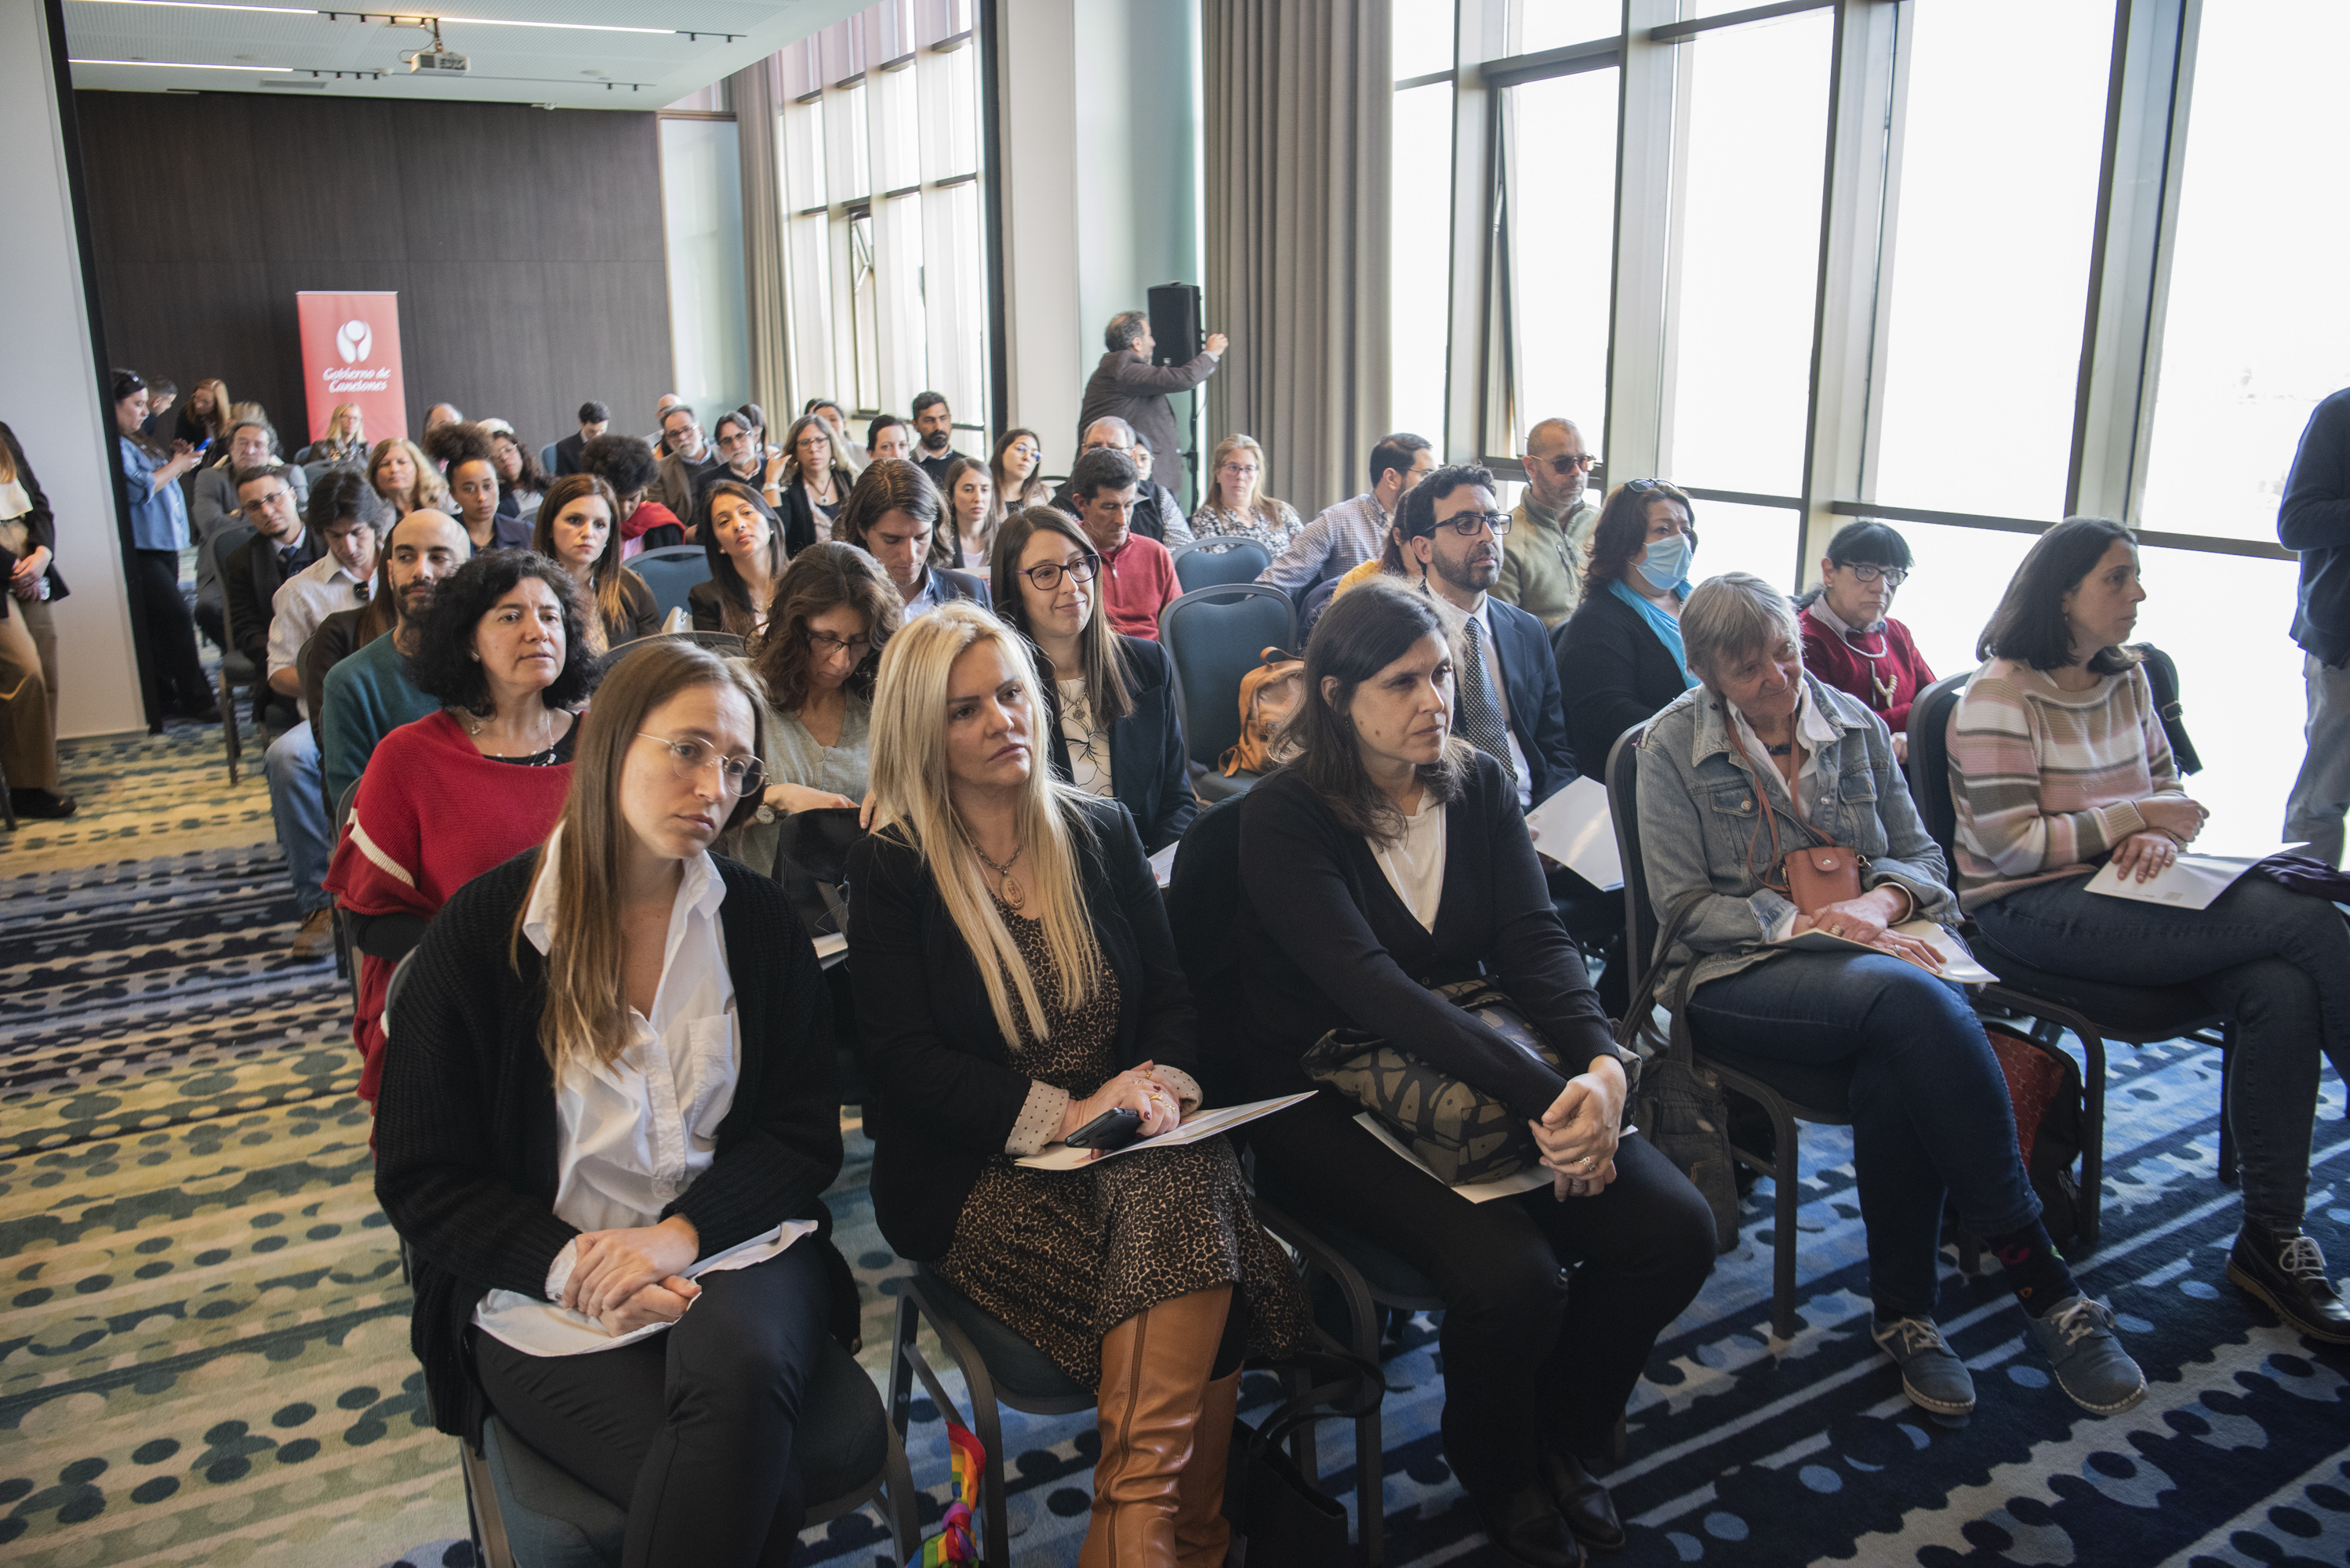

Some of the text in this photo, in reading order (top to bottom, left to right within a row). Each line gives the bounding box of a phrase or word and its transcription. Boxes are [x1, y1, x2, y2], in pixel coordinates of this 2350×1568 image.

[322, 366, 392, 381] Gobierno de
[329, 379, 388, 394] Canelones
